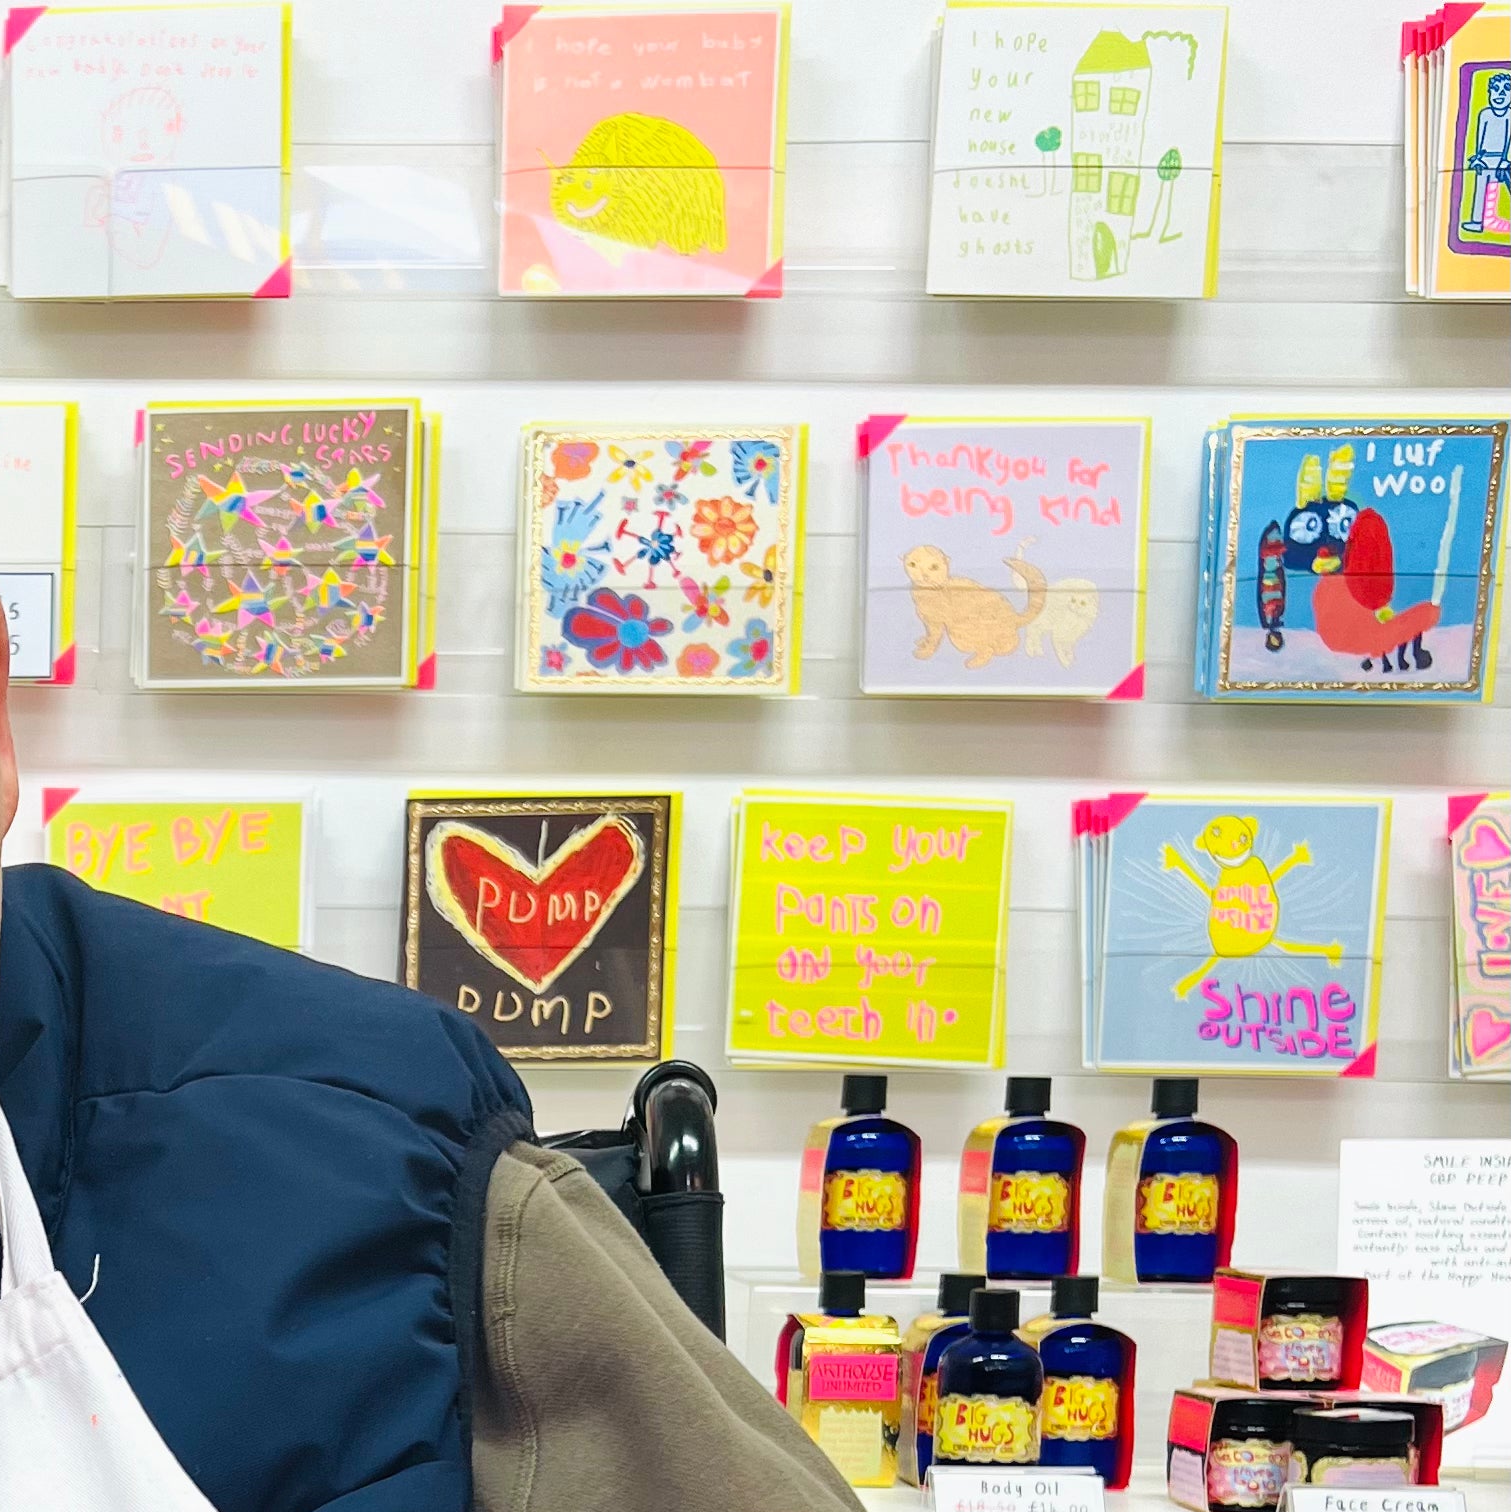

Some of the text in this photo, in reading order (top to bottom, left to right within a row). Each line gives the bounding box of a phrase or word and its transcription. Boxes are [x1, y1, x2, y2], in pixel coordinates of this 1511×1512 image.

[972, 31, 1048, 54] I hope
[968, 67, 1034, 91] your
[969, 108, 1013, 123] new
[968, 138, 1016, 155] house
[959, 207, 1011, 225] have
[958, 240, 1035, 259] ghosts
[165, 411, 376, 480] SENDING LUCKY
[316, 443, 392, 470] STARS
[1366, 438, 1445, 467] I luf
[887, 442, 1111, 490] Thankyou for
[900, 483, 1122, 537] being kind
[66, 808, 270, 881] BYE BYE
[760, 820, 983, 874] keep your
[475, 876, 603, 934] PUMP
[890, 894, 941, 935] on
[776, 943, 937, 990] and your
[1198, 977, 1357, 1033] Shine
[764, 995, 882, 1043] teeth
[1424, 1155, 1471, 1169] SMILE
[843, 1178, 874, 1200] BIG
[1000, 1179, 1030, 1201] BIG
[1163, 1181, 1194, 1203] BIG
[854, 1195, 894, 1217] HUGS
[1013, 1196, 1054, 1217] HUGS
[1176, 1197, 1212, 1219] HUGS
[811, 1362, 894, 1381] ARTHOUSE
[822, 1379, 882, 1393] UNLIMITED
[1054, 1385, 1086, 1408] BIG
[955, 1402, 987, 1428] BIG
[1066, 1401, 1108, 1426] HUGS
[968, 1421, 1015, 1446] HUGS
[980, 1480, 1060, 1498] Body Oil
[1324, 1495, 1369, 1512] Face
